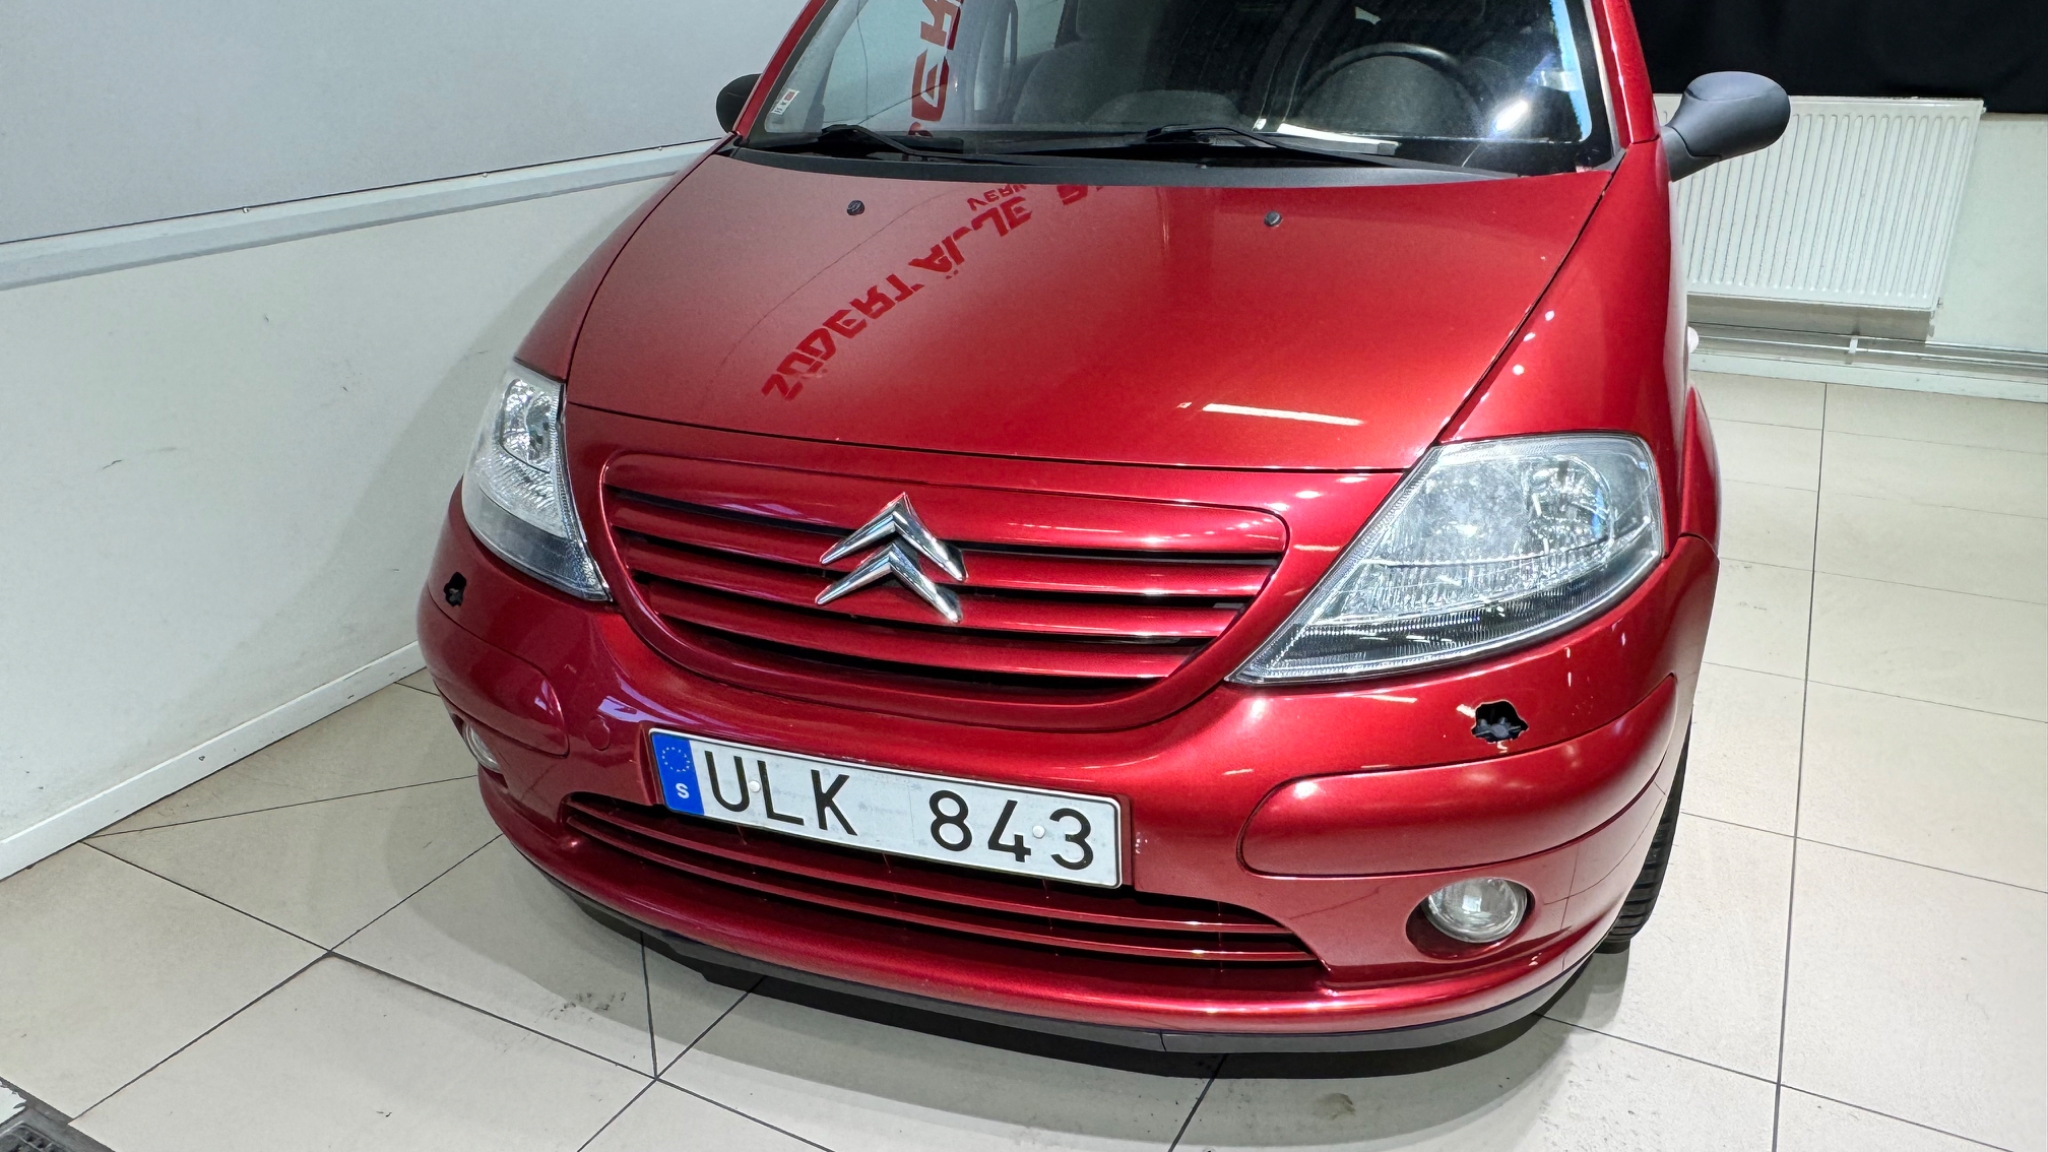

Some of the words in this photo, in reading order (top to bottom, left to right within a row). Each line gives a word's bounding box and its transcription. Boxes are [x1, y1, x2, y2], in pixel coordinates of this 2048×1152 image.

[675, 782, 690, 799] S
[704, 750, 858, 837] ULK
[929, 789, 1095, 871] 843
